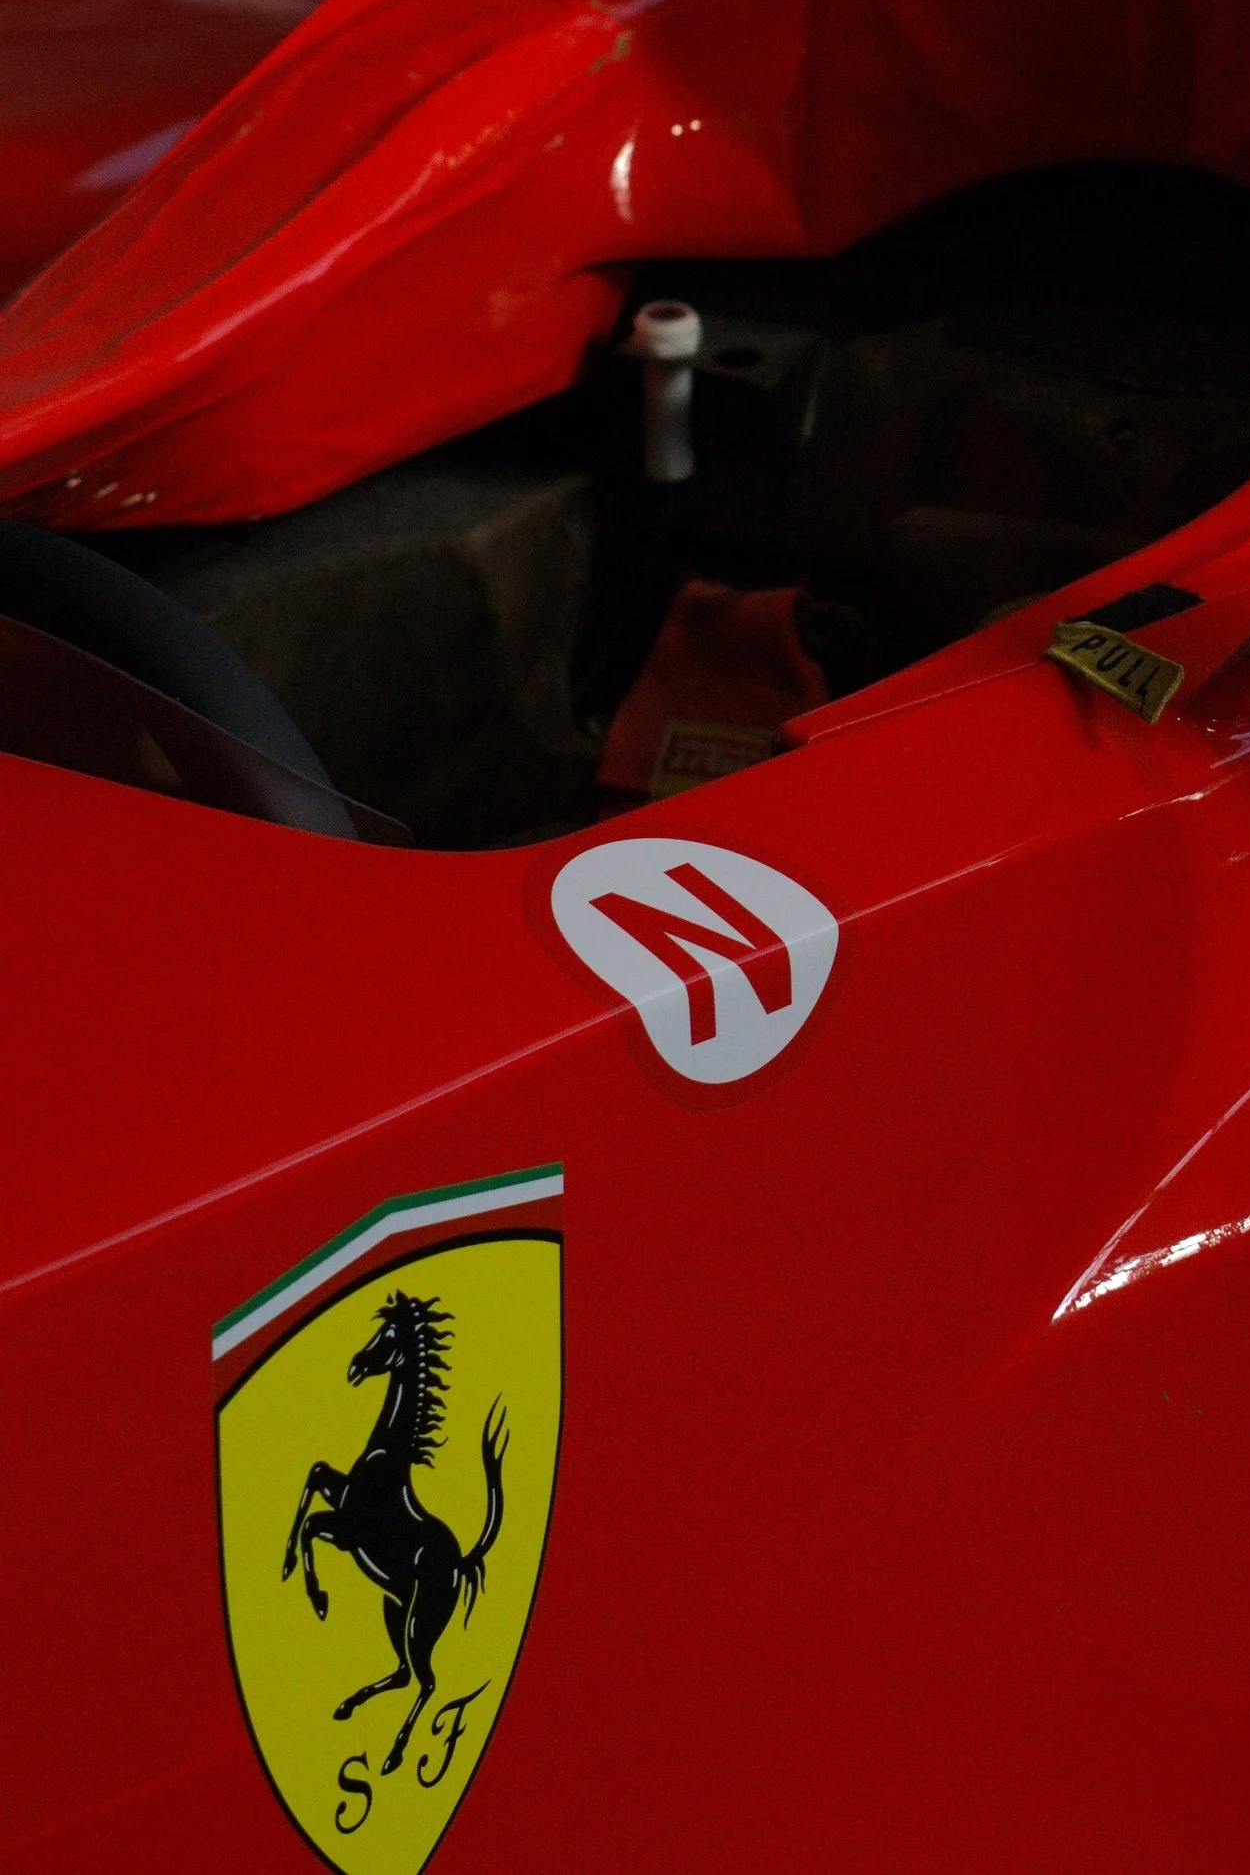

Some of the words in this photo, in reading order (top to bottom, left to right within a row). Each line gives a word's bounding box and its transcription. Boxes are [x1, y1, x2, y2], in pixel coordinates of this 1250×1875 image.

[1070, 633, 1161, 697] PULL
[588, 862, 792, 1047] N
[335, 1750, 373, 1834] S
